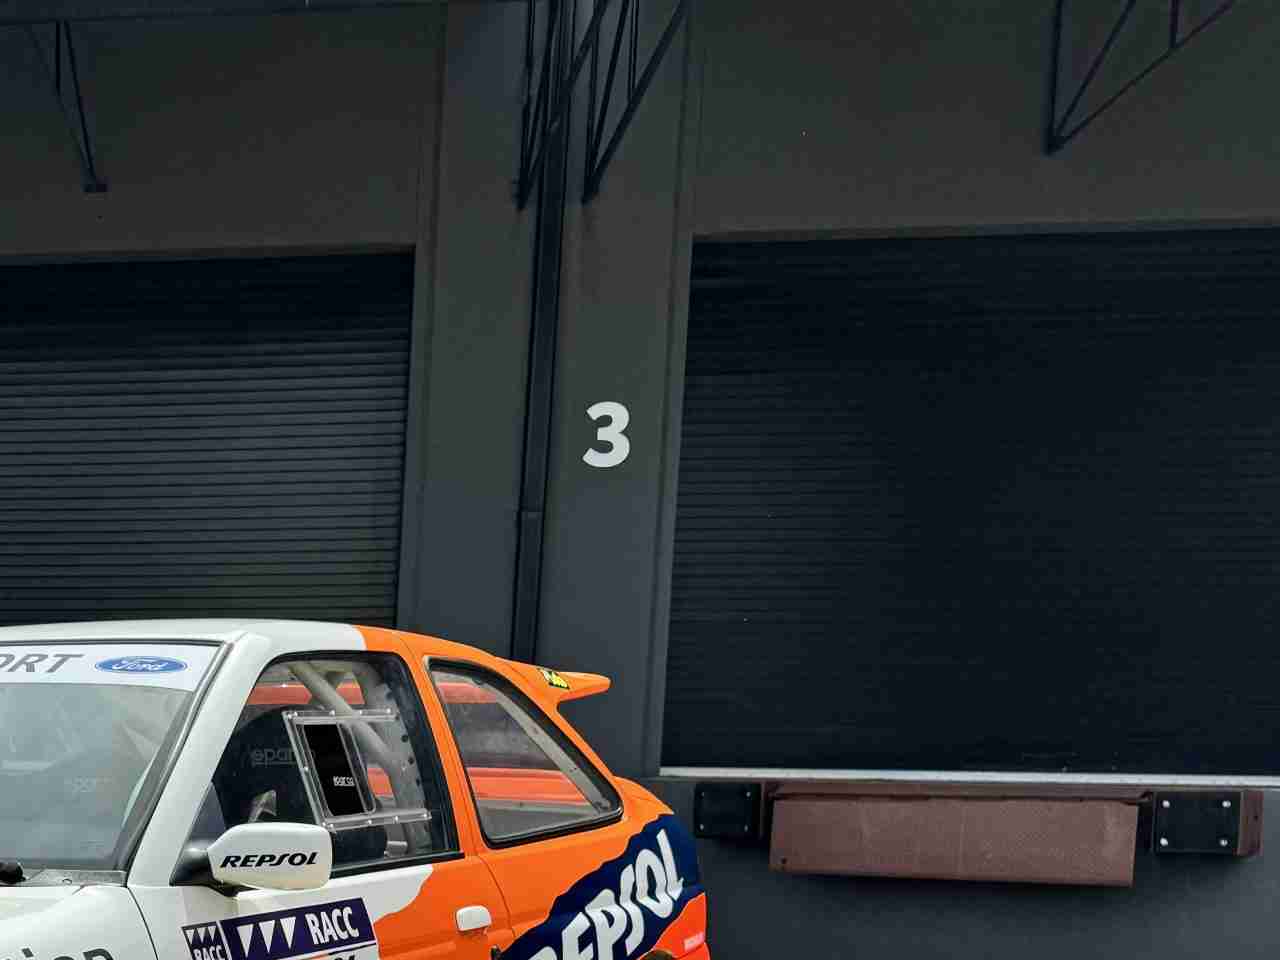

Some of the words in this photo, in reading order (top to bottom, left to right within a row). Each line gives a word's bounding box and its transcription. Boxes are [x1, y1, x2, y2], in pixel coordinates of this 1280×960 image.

[582, 401, 630, 468] 3
[221, 852, 319, 868] REPSOL
[305, 906, 359, 945] RACC
